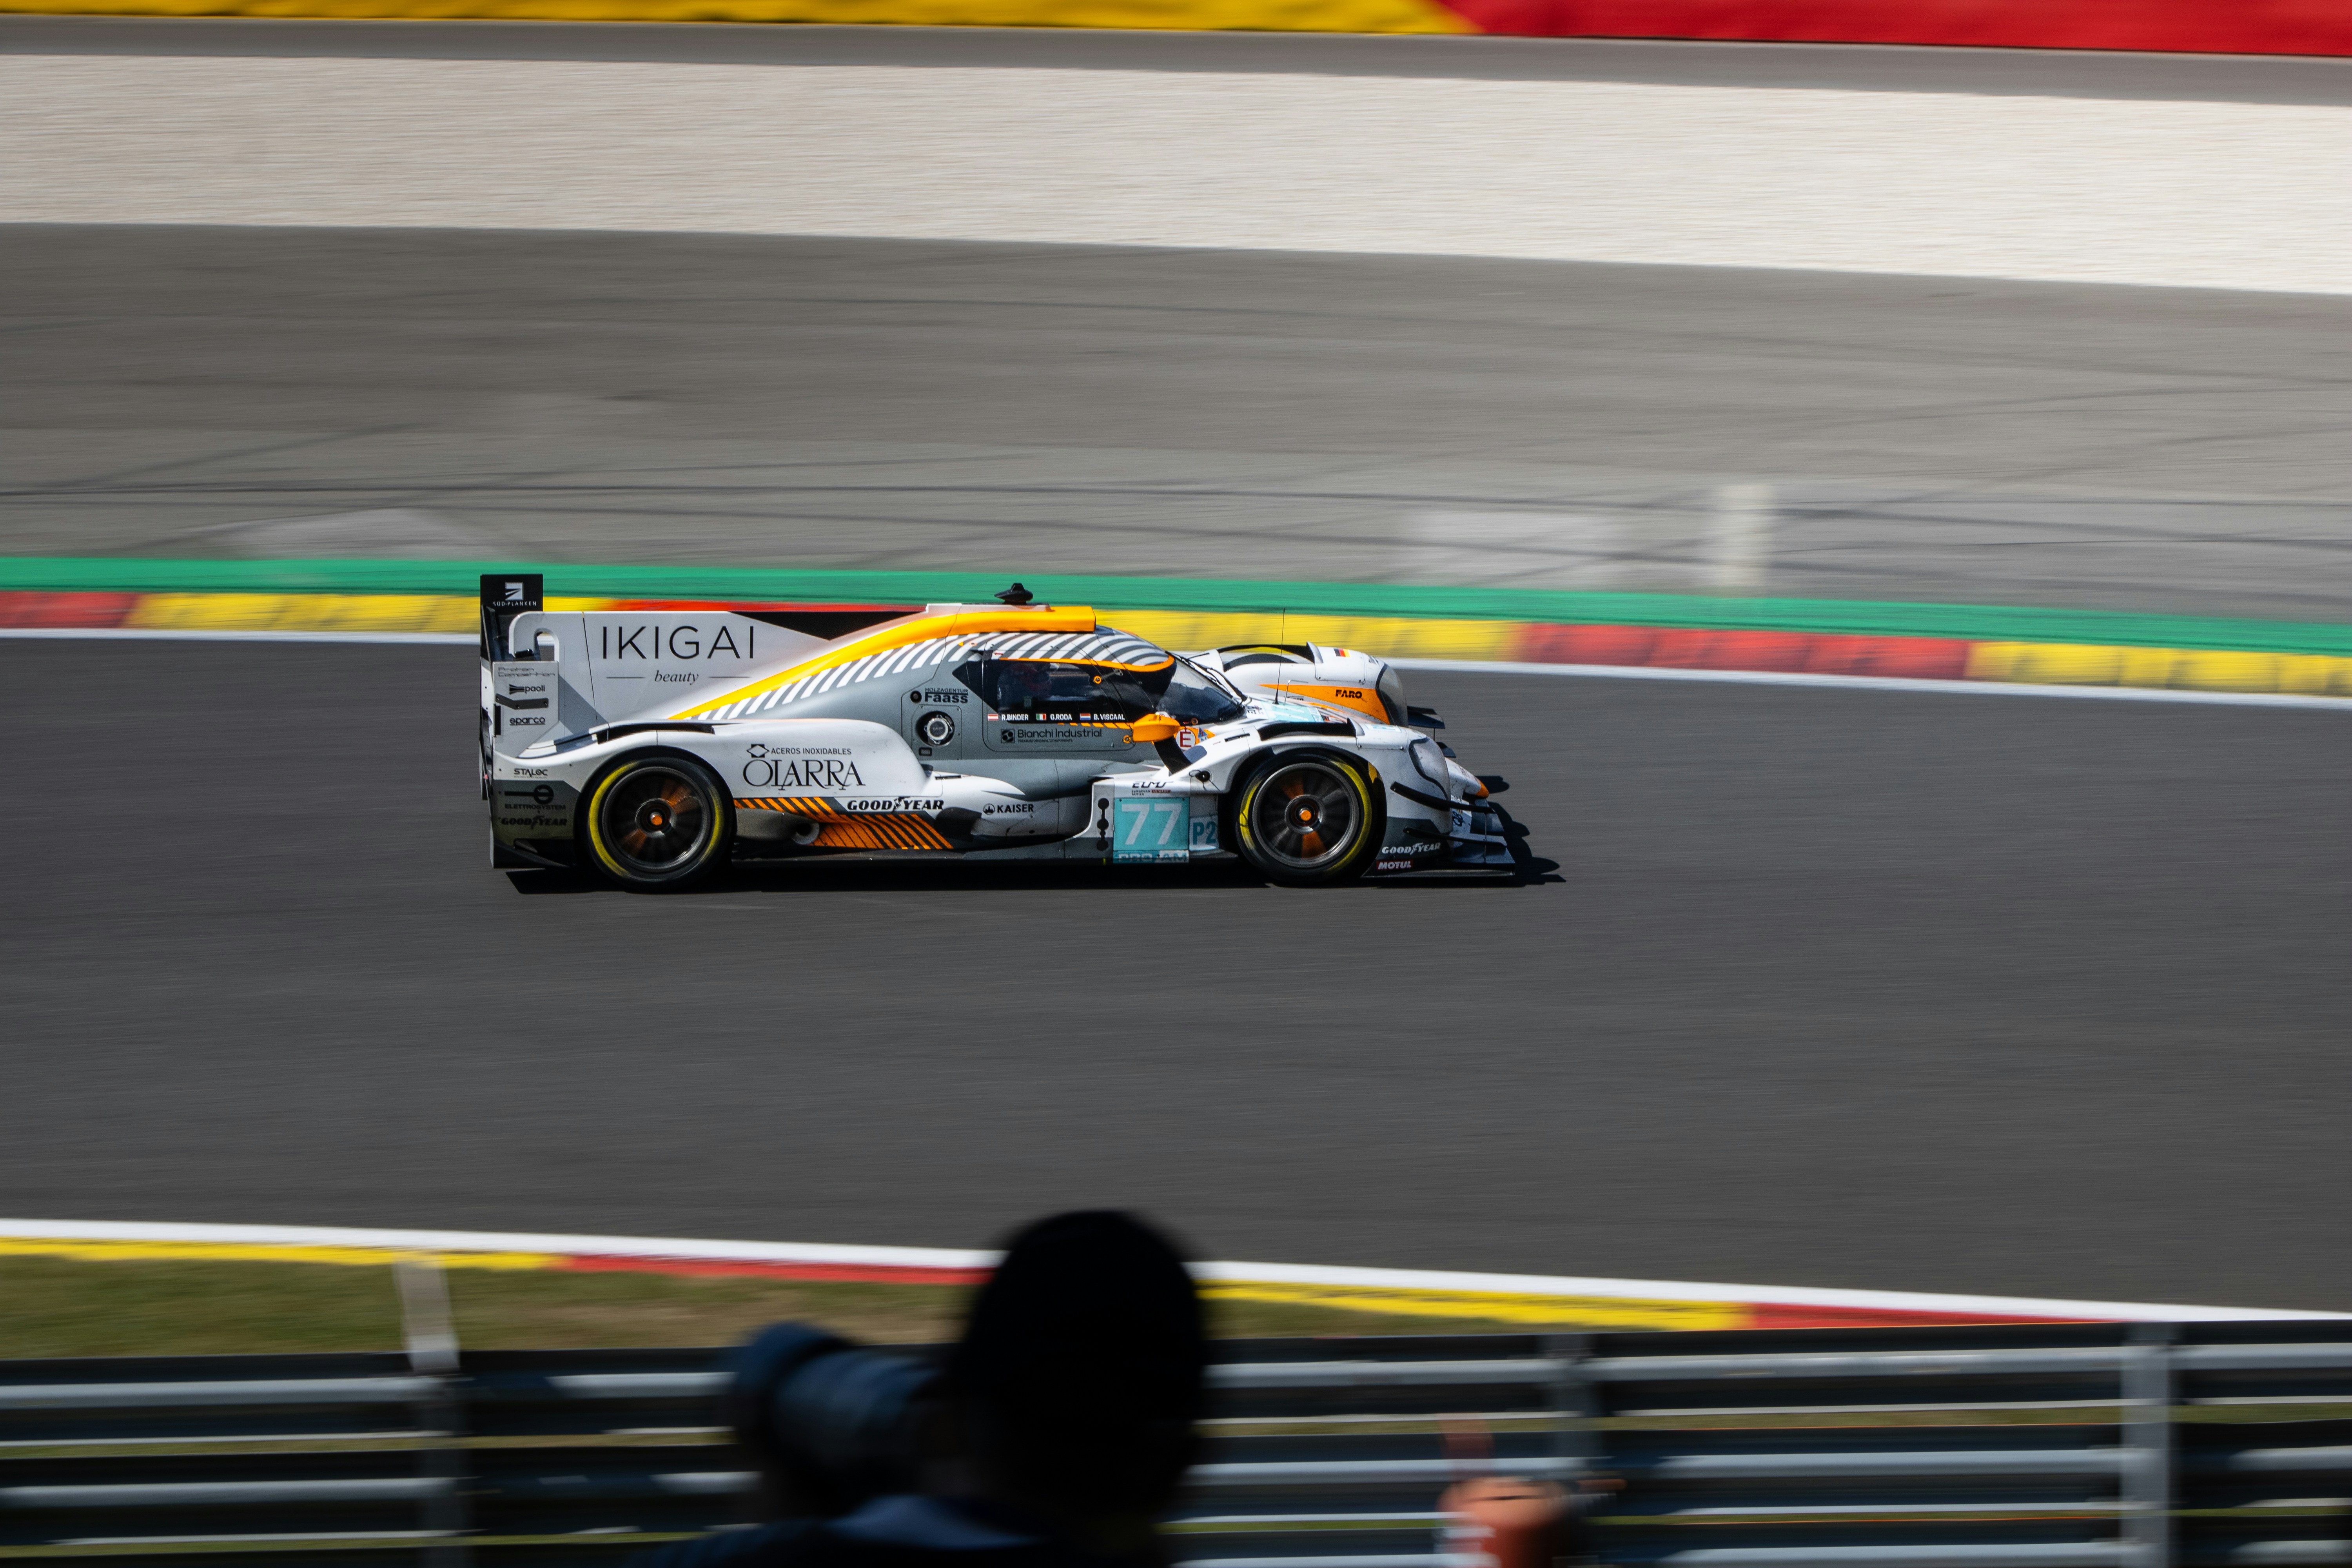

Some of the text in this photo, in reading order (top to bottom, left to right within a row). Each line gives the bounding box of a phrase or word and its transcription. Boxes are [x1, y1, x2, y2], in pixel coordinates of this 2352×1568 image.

[603, 626, 753, 659] IKIGAI
[654, 670, 699, 684] beauty
[525, 685, 545, 694] paoli
[1336, 690, 1362, 699] FARO
[924, 693, 968, 704] Faass
[1018, 728, 1102, 739] Bianchi Industrial
[1180, 731, 1192, 747] E
[514, 768, 548, 777] STALOC
[743, 759, 866, 791] OLARRA
[847, 797, 944, 811] GOODYEAR
[997, 804, 1034, 813] KAISER
[1122, 803, 1182, 845] 77
[1193, 821, 1217, 845] P2
[1382, 842, 1441, 855] GOODYEAR
[1378, 861, 1411, 869] MOTUL
